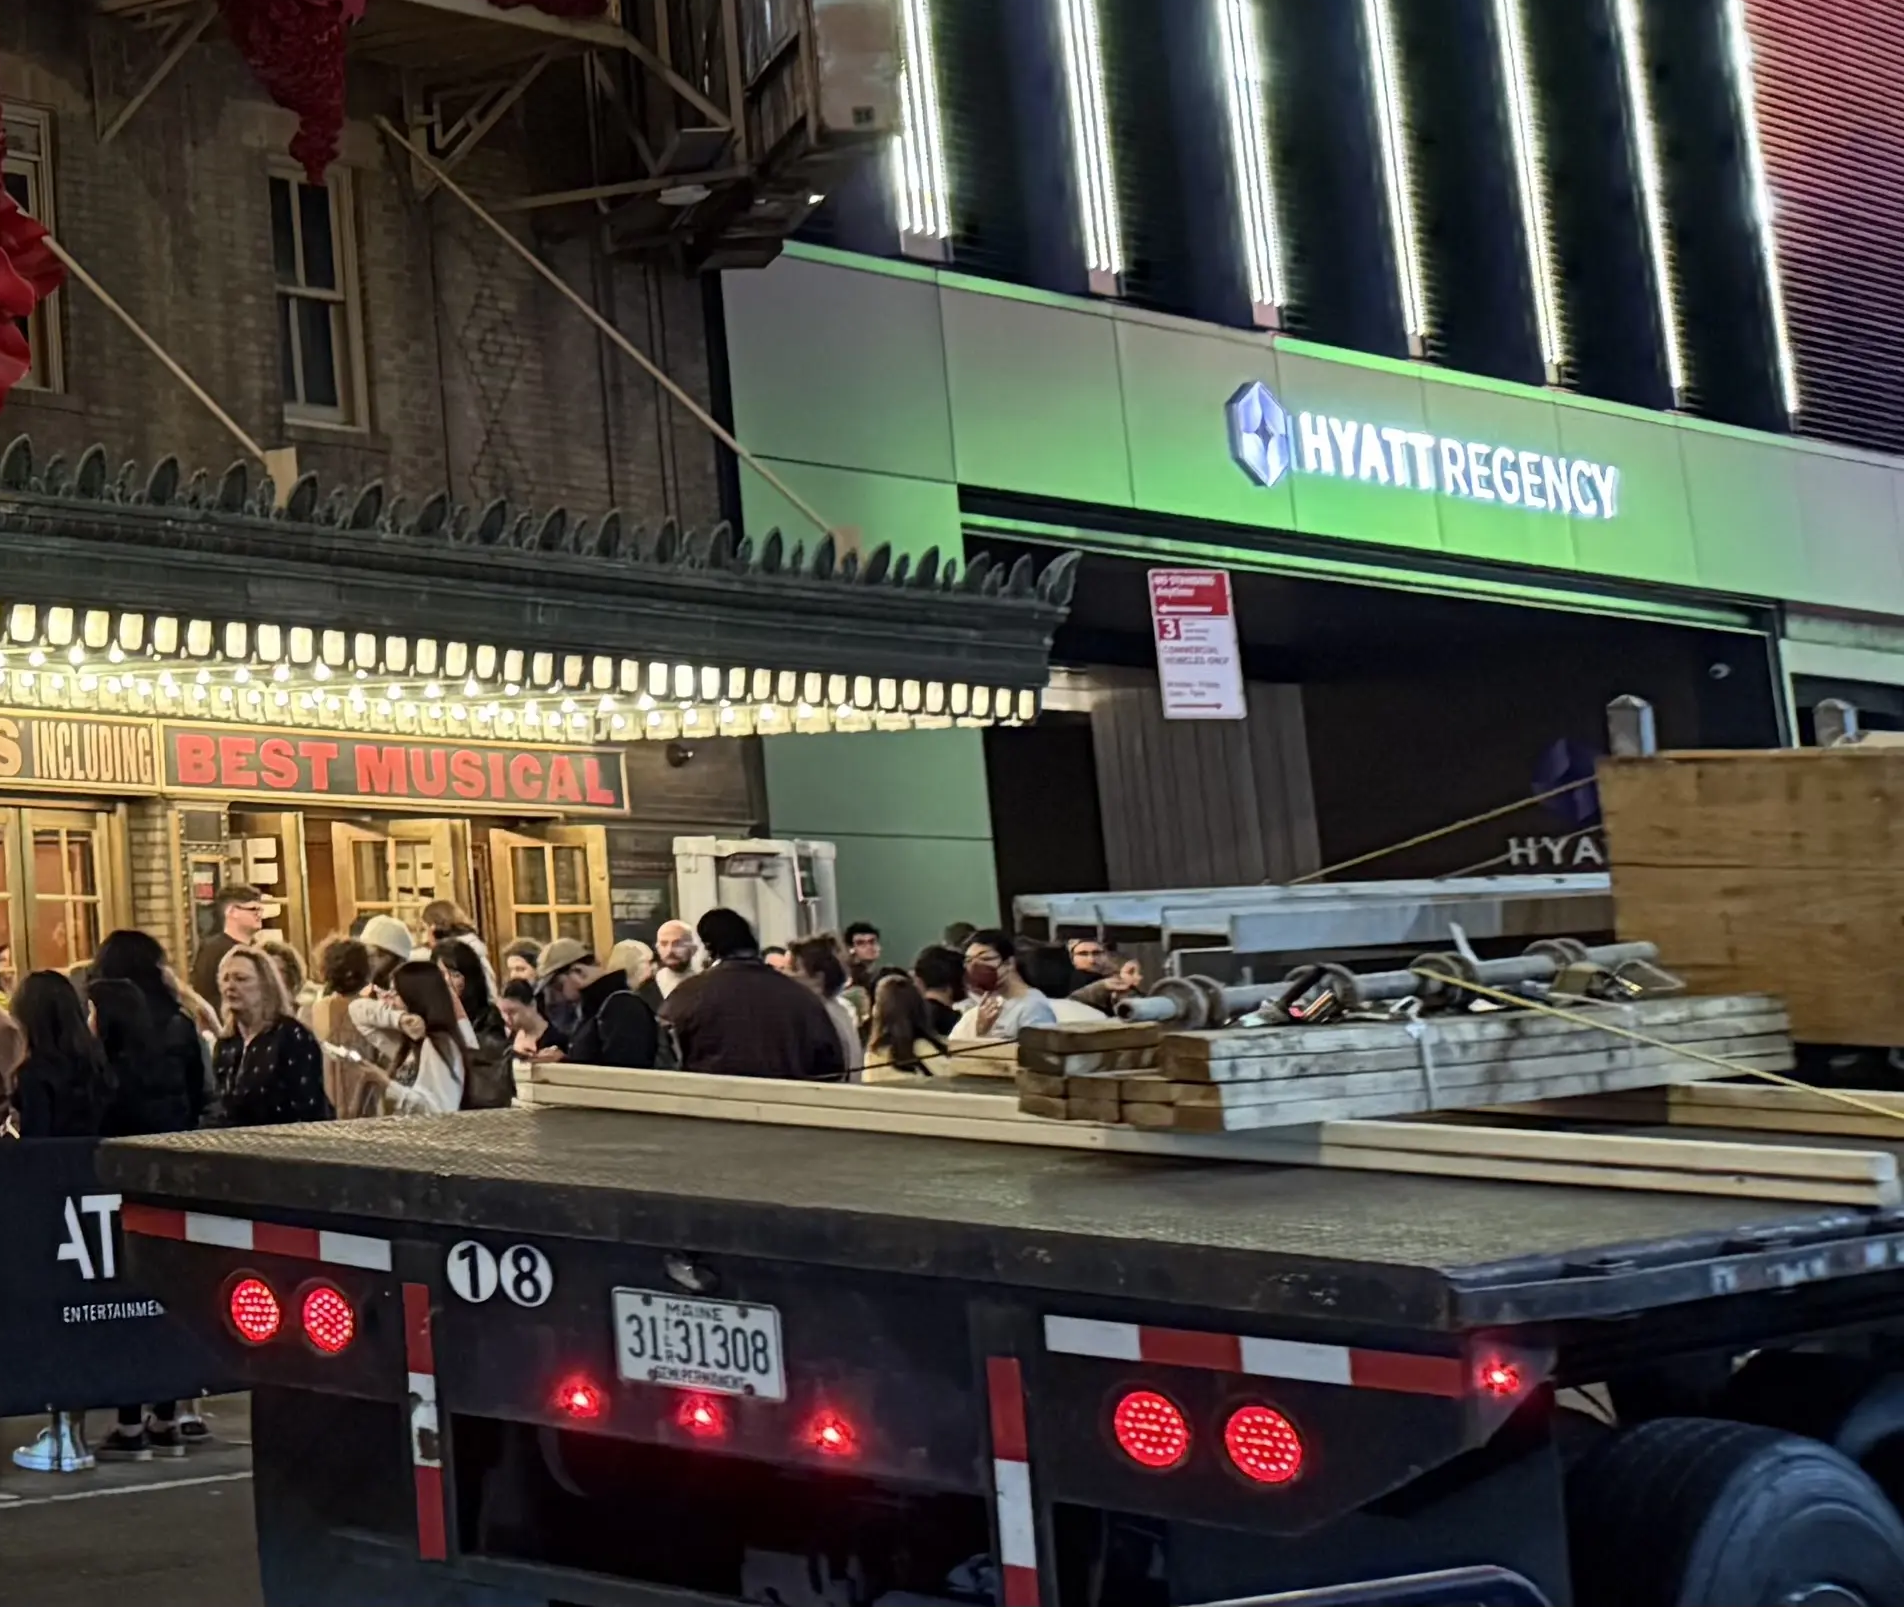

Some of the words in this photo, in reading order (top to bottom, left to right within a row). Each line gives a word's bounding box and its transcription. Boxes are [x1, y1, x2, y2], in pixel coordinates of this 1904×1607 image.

[1298, 411, 1436, 489] HYATT
[1439, 438, 1619, 519] REGENCY
[1162, 618, 1177, 639] 3
[31, 720, 154, 784] INCLUDING
[175, 733, 338, 791] BEST
[354, 744, 616, 805] MUSICAL
[1508, 836, 1604, 866] HYA
[57, 1194, 122, 1279] AT
[458, 1244, 539, 1304] 18
[63, 1299, 166, 1323] ENTERTAINME
[665, 1302, 724, 1322] MAINE
